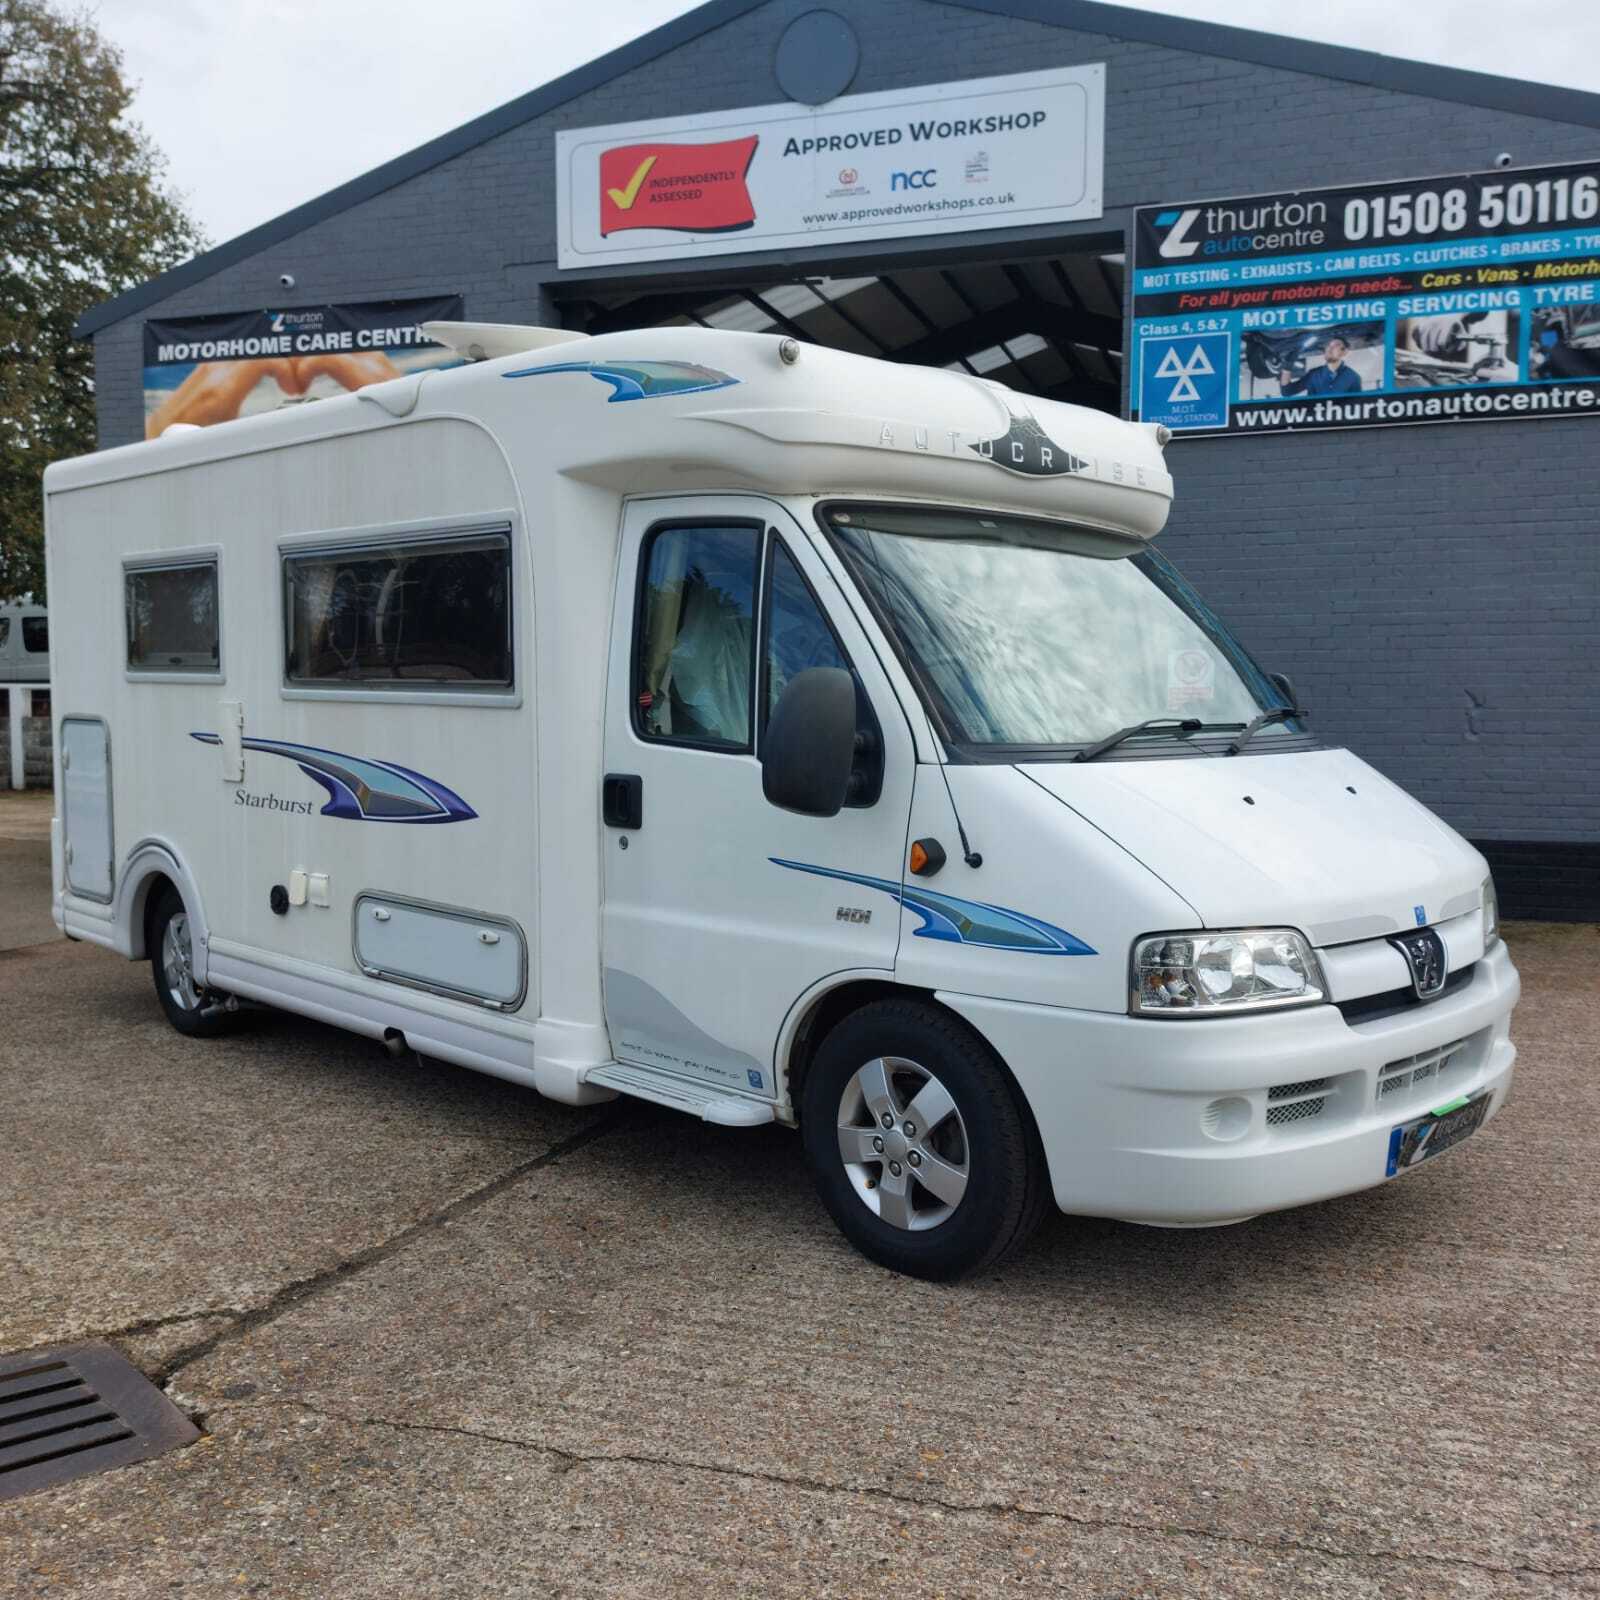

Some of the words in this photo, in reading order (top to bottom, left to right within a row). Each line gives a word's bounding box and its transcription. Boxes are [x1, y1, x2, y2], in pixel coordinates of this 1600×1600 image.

[650, 170, 736, 188] INDEPENDENTLY
[649, 189, 702, 203] ASSESSED
[802, 193, 1015, 224] www.approvedworkshops.co.uk
[1344, 189, 1467, 241] 01508
[1478, 176, 1599, 228] 50116
[1206, 201, 1326, 234] thurton
[1203, 229, 1325, 255] autocentre
[1143, 274, 1171, 288] MOT
[1174, 268, 1229, 285] TESTING
[1241, 261, 1312, 279] EXHAUSTS
[1324, 257, 1355, 272] CAM
[1358, 253, 1400, 269] BELTS
[1413, 245, 1488, 264] CLUTCHES
[1500, 238, 1560, 257] BRAKES
[1180, 294, 1207, 308] For
[1209, 291, 1229, 306] all
[1231, 288, 1269, 308] your
[1272, 281, 1345, 300] motoring
[1421, 272, 1462, 288] Cars
[1476, 268, 1519, 283] Vans
[1534, 259, 1600, 279] Motorh
[1533, 284, 1594, 304] TYRE
[1243, 309, 1289, 327] MOT
[1295, 301, 1385, 322] TESTING
[1398, 290, 1520, 315] SERVICING
[1140, 323, 1178, 335] Class
[1182, 321, 1193, 333] 4,
[158, 336, 291, 362] MOTORHOME
[296, 332, 352, 351] CARE
[1184, 413, 1218, 423] STATION
[234, 789, 313, 815] Starburst
